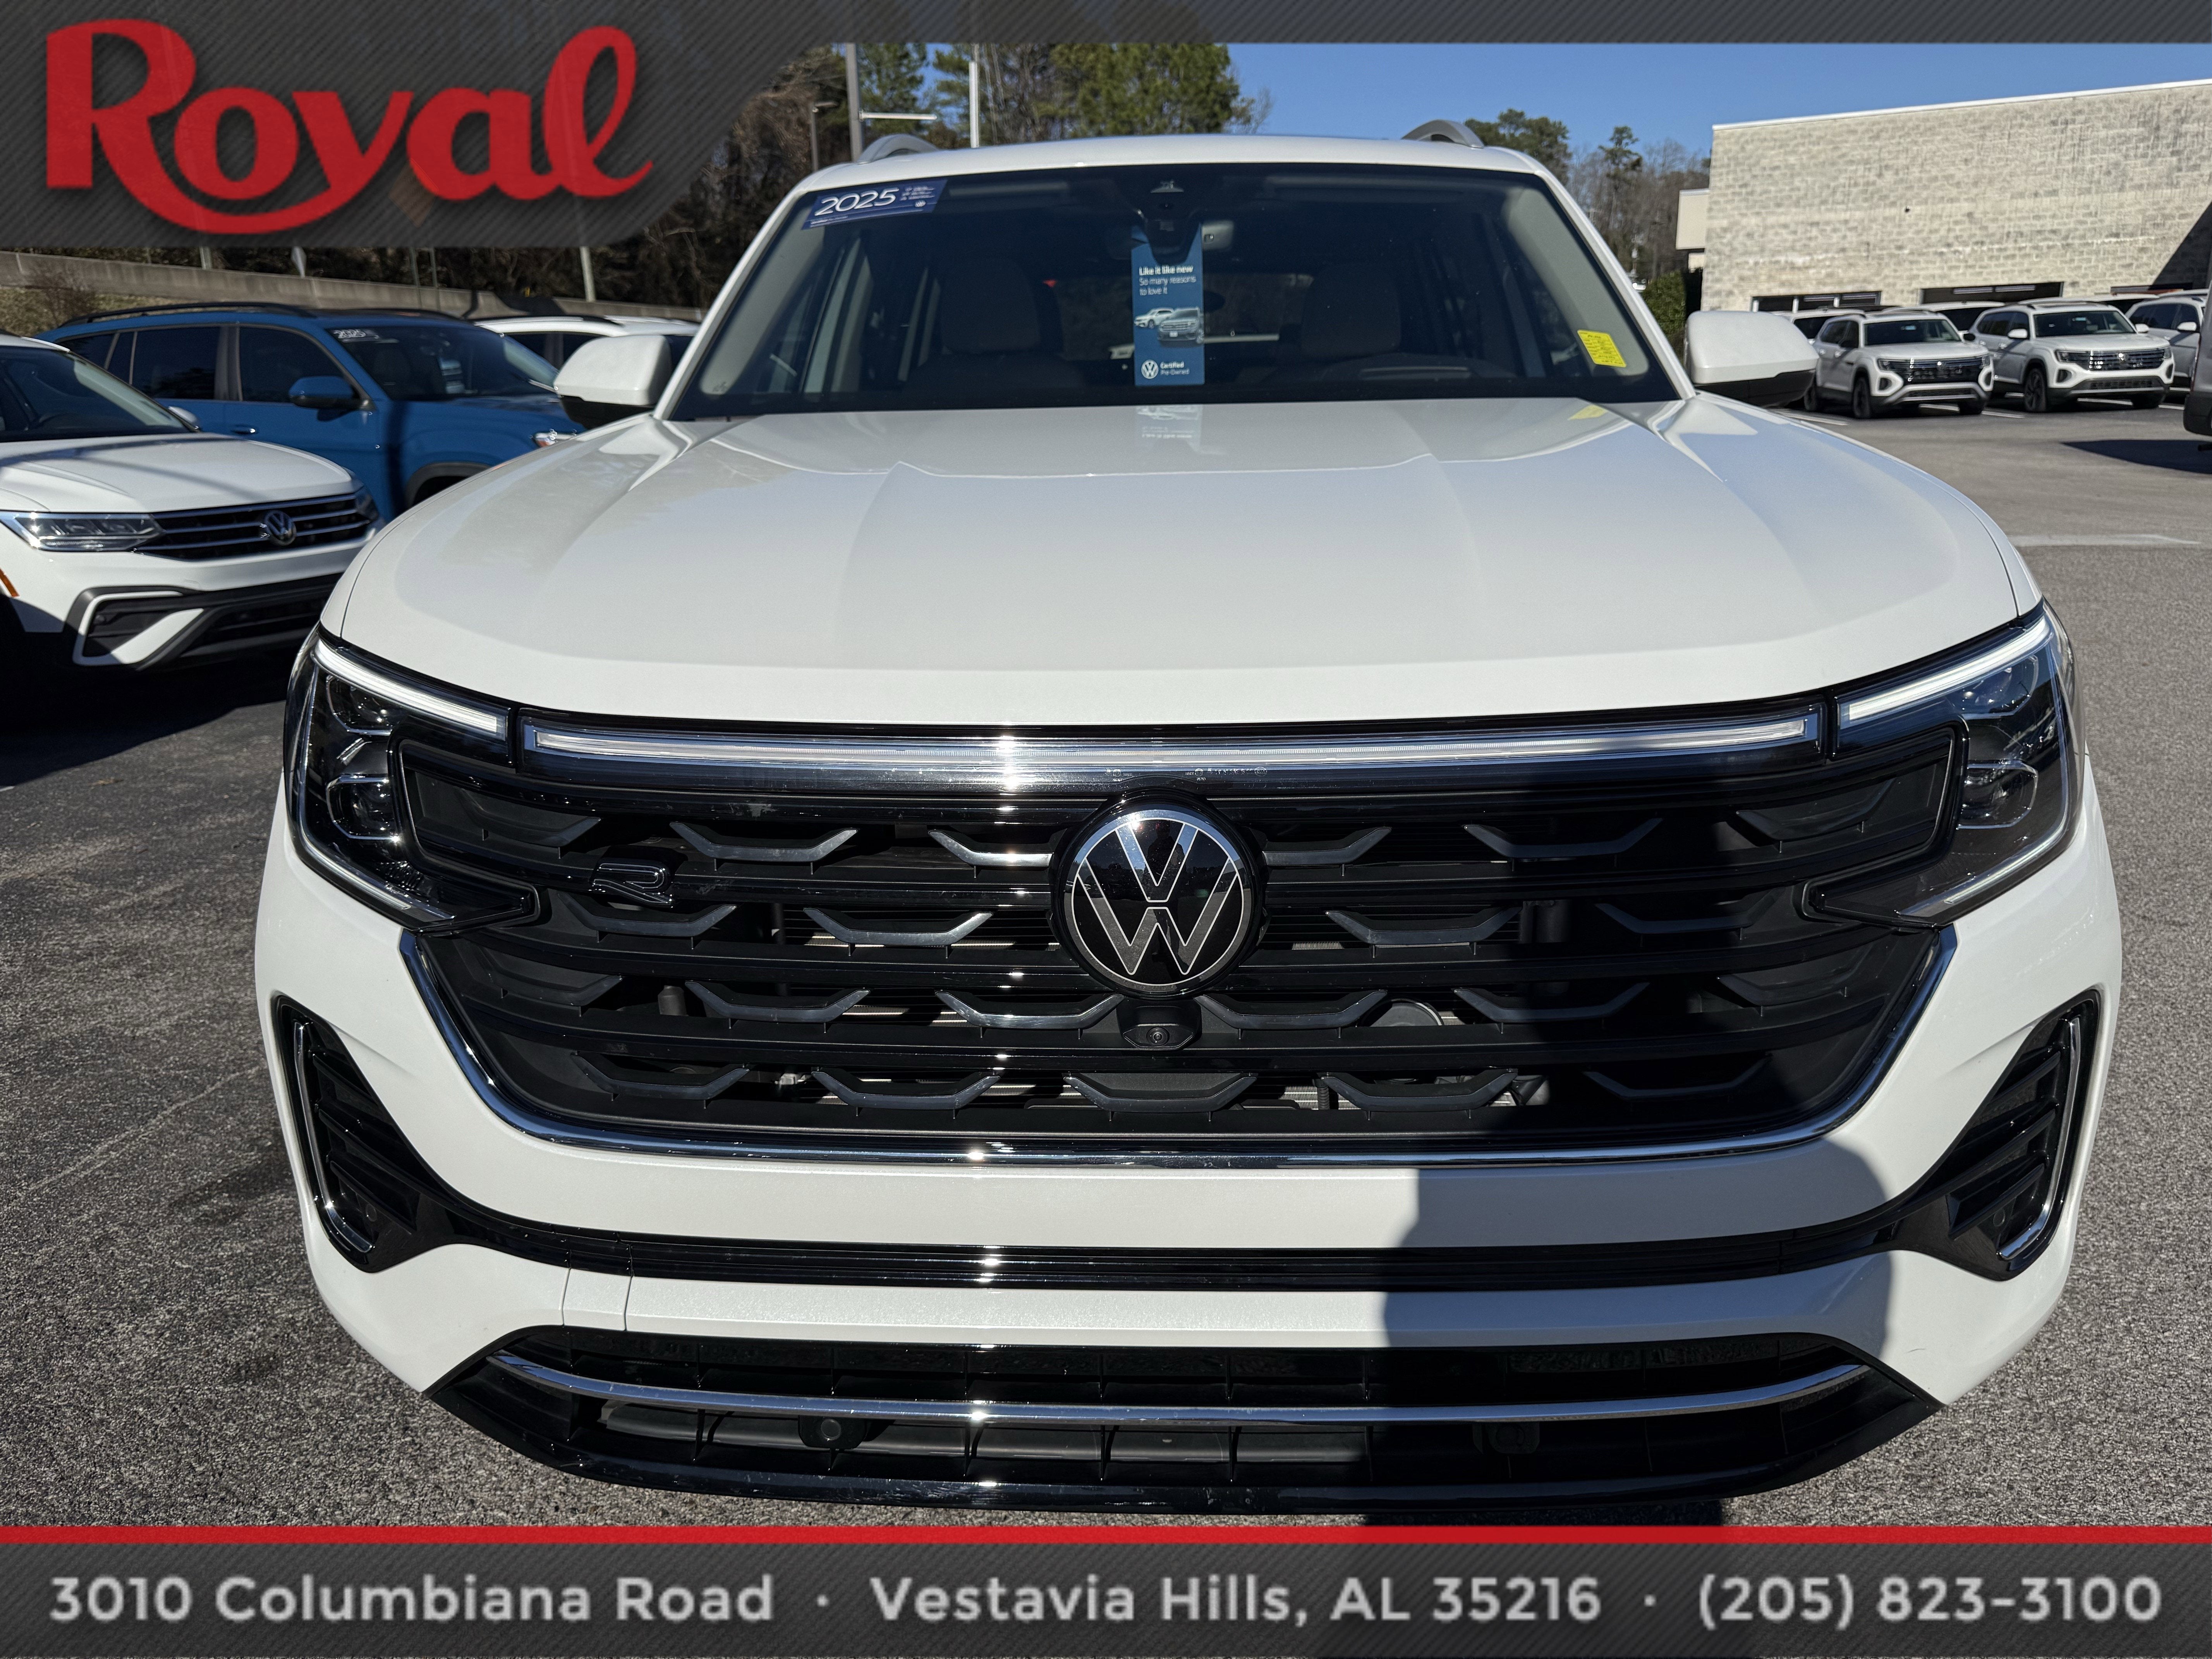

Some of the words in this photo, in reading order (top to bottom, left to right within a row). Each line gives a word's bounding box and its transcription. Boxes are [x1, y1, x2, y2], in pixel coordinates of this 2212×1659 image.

[814, 187, 900, 216] 2025
[1139, 266, 1154, 276] Like
[1155, 265, 1161, 275] it
[1162, 264, 1176, 274] like
[1176, 265, 1194, 273] new
[1139, 277, 1149, 286] So
